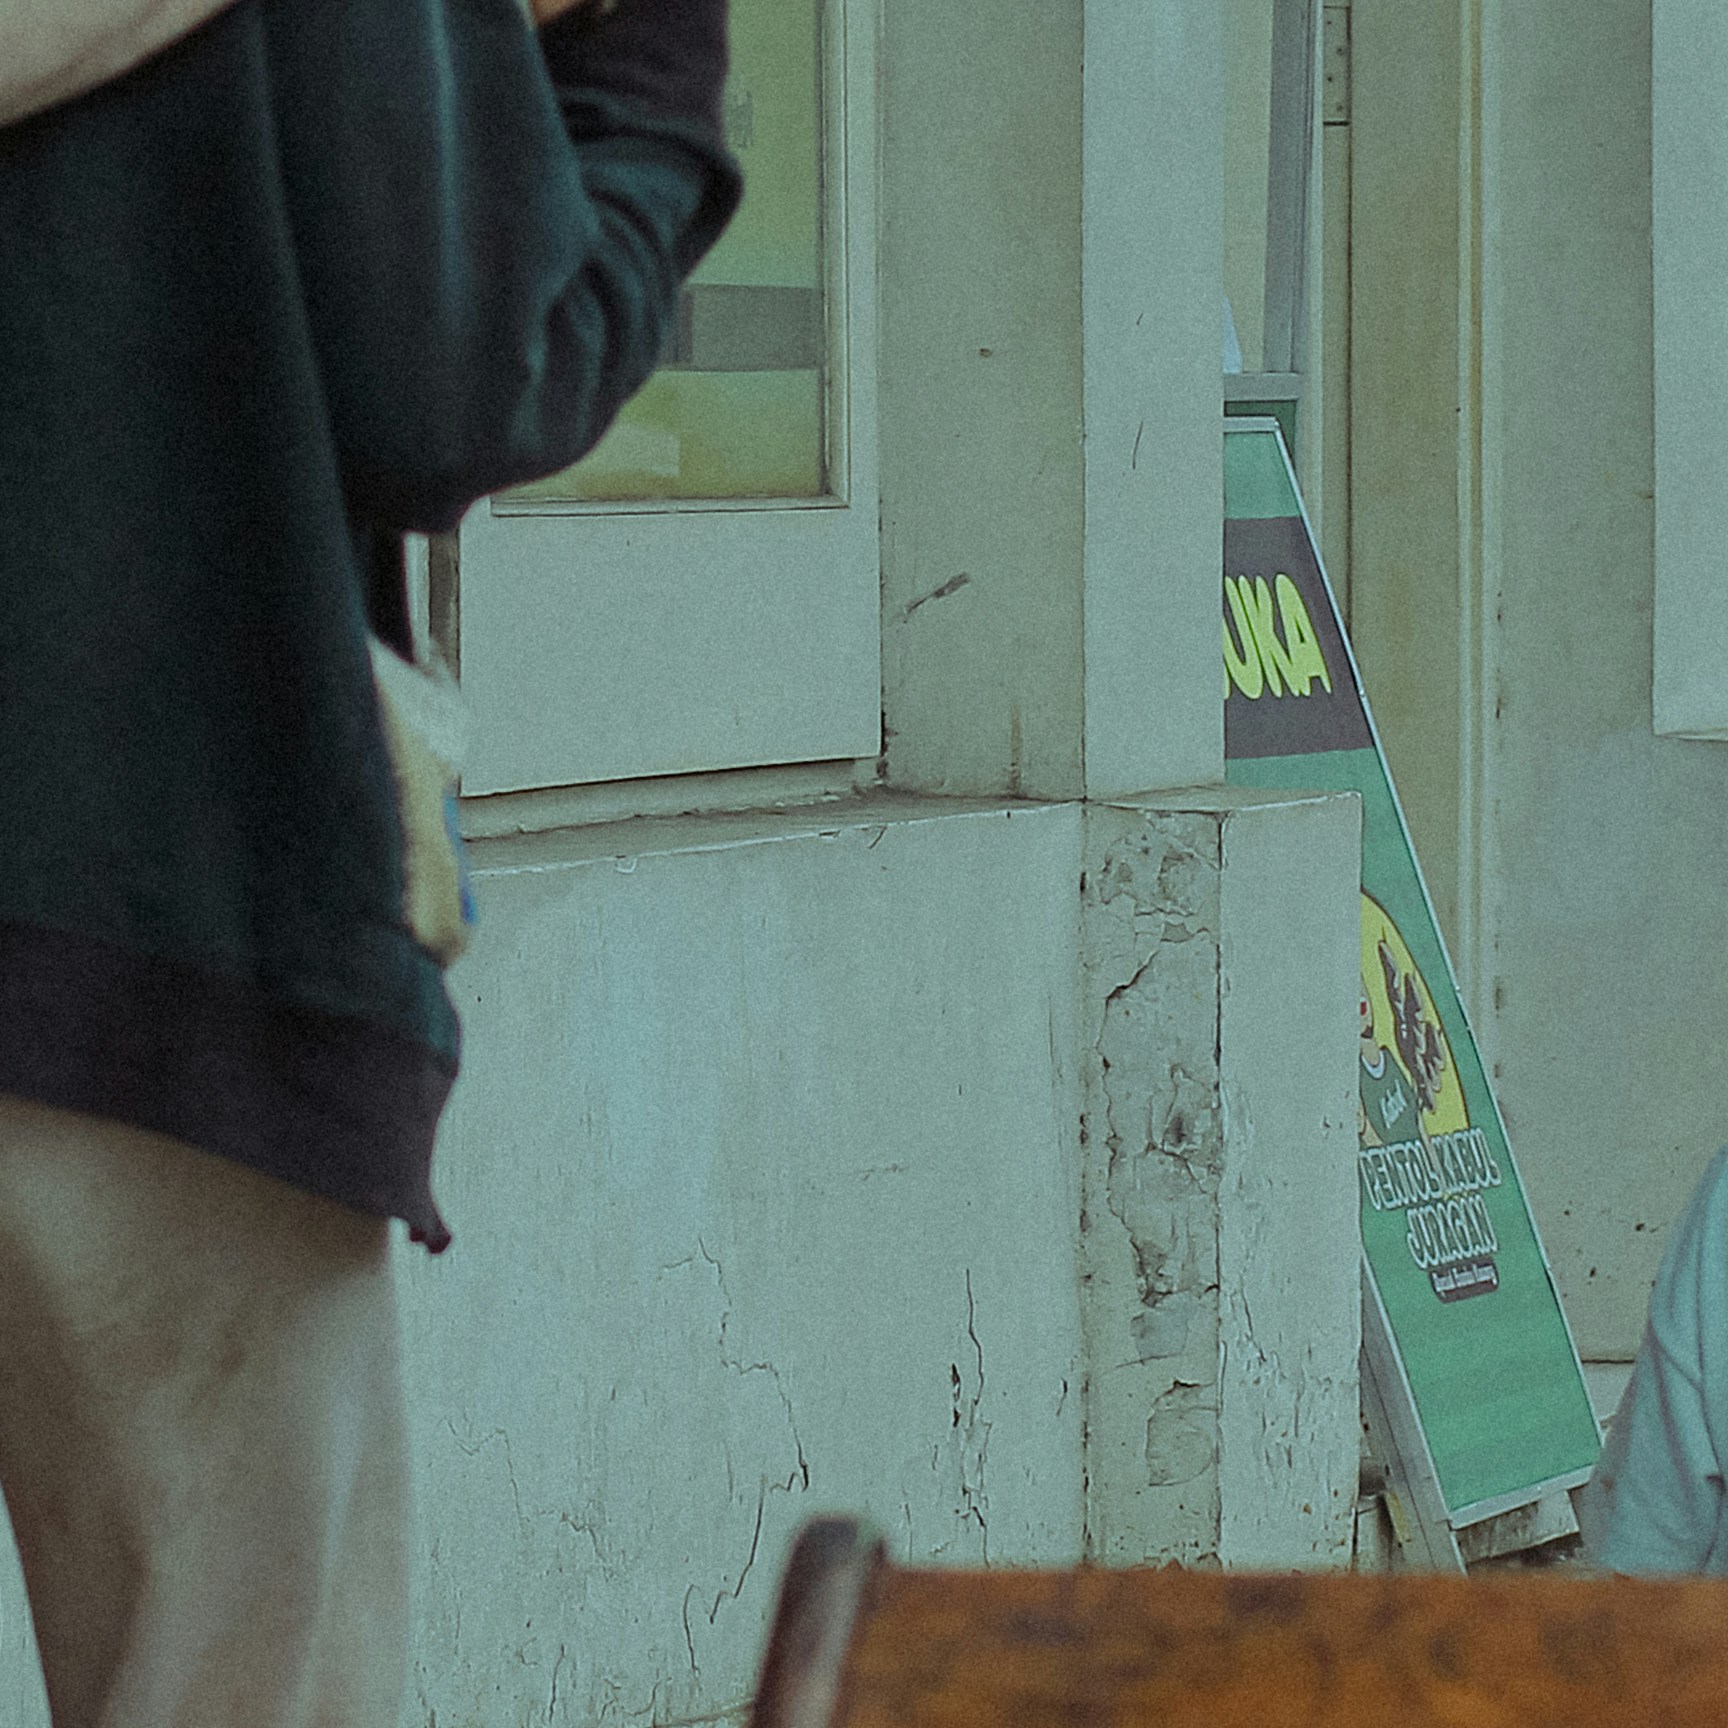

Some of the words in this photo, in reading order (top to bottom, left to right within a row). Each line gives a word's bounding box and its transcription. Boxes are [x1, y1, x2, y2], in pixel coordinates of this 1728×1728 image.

[1359, 1139, 1443, 1211] PENTOL
[1431, 1127, 1501, 1194] KABUL
[1407, 1194, 1498, 1269] JURAGAN
